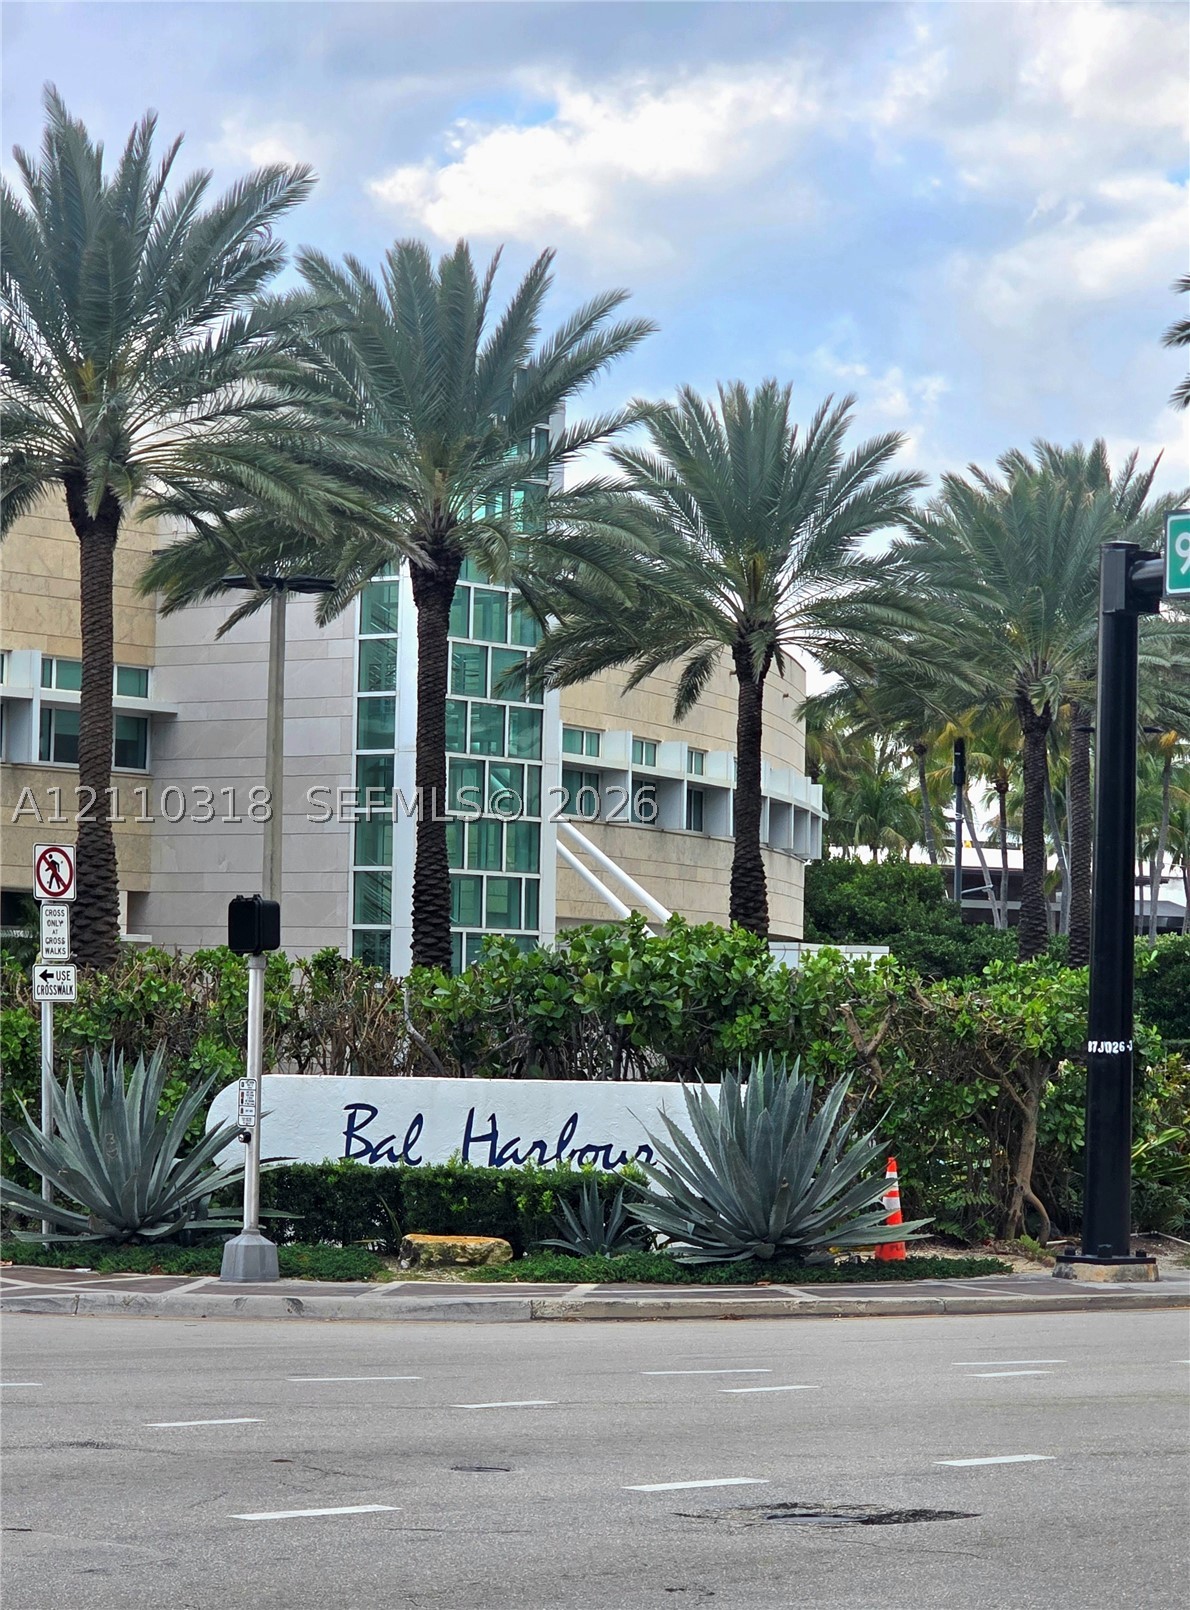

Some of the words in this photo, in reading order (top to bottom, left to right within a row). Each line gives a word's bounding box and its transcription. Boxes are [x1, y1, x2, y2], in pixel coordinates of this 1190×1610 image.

[45, 909, 65, 917] CROSS
[47, 919, 64, 927] ONLY
[45, 937, 66, 945] CROSS
[45, 947, 66, 955] WALKS
[56, 970, 71, 981] USE
[36, 984, 73, 996] CROSSWALK
[338, 1102, 424, 1166] Bal
[462, 1106, 658, 1170] Harbour
